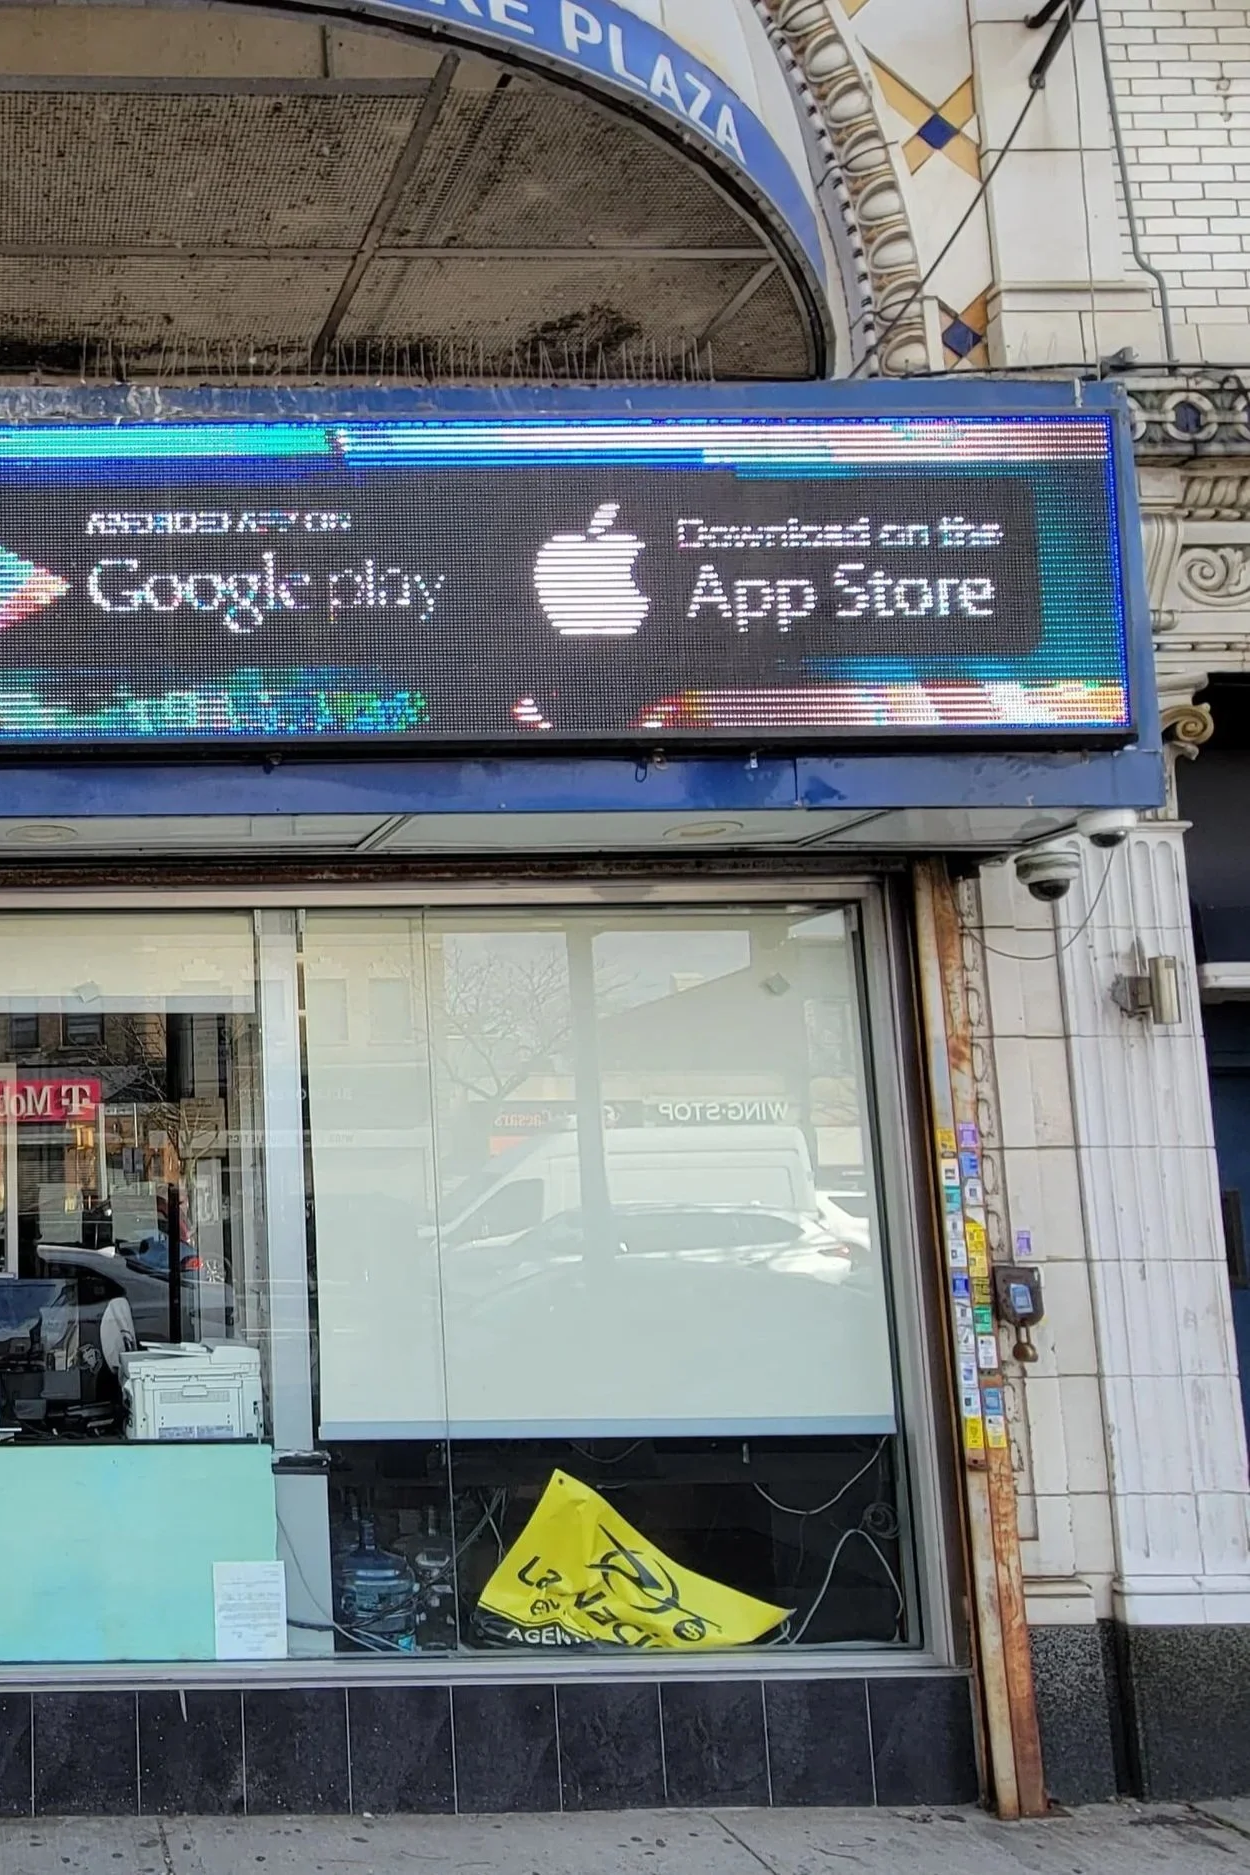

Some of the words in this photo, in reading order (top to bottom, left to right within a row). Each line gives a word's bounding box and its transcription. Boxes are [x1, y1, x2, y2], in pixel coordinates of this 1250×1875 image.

[559, 0, 747, 165] PLAZA
[88, 551, 313, 633] Google
[327, 558, 446, 624] play
[686, 564, 818, 633] App
[832, 562, 996, 617] Store
